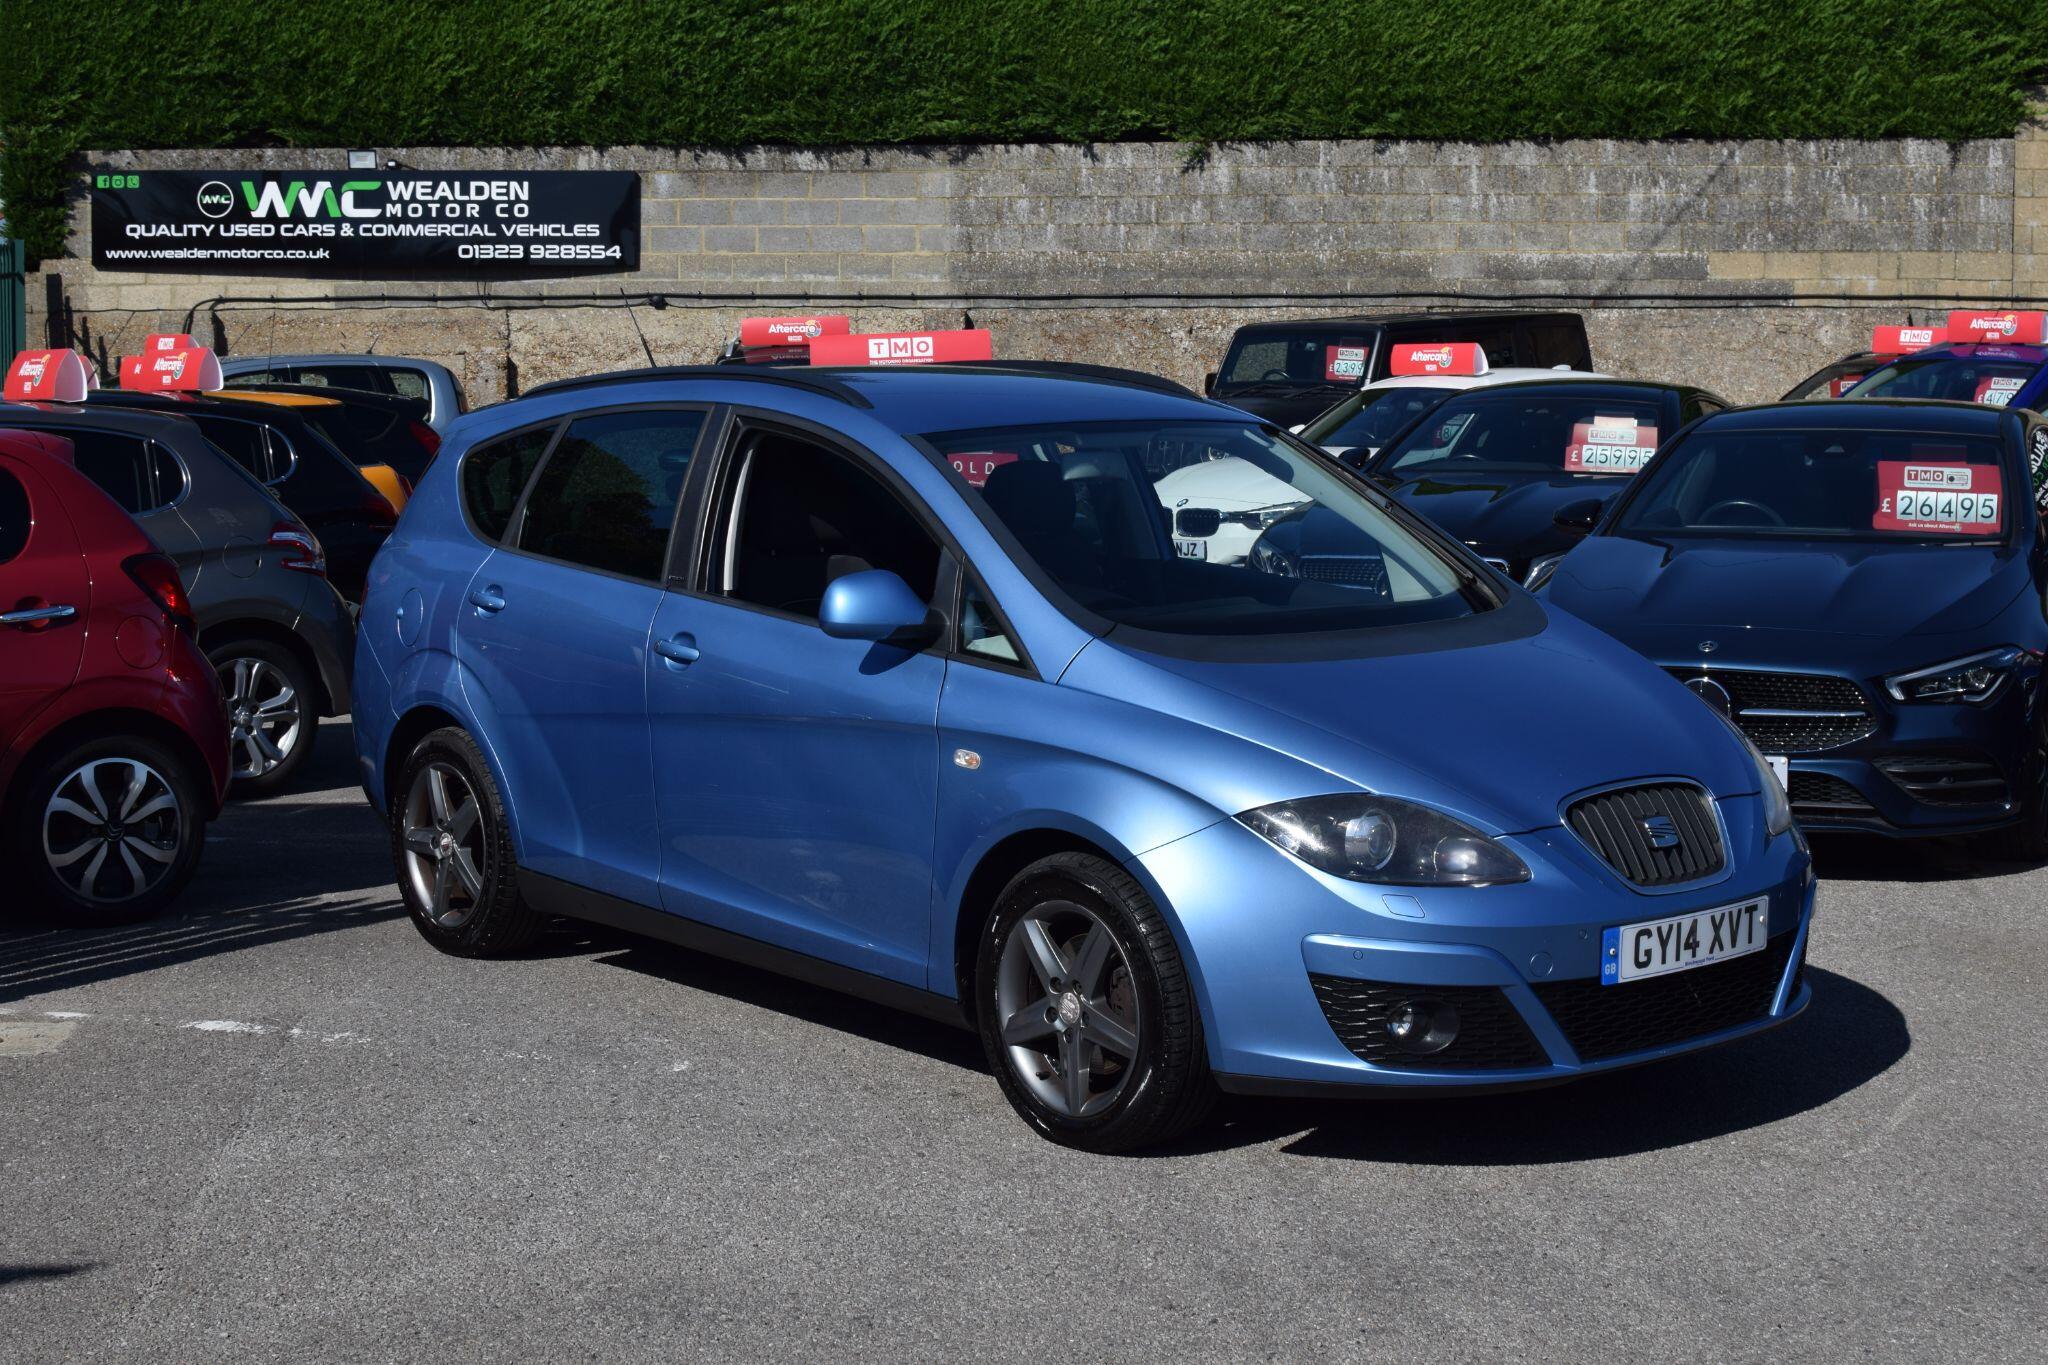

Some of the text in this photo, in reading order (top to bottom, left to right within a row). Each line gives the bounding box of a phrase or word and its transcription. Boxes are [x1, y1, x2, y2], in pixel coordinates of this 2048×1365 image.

[386, 181, 530, 201] WEALDEN
[241, 181, 382, 218] WMC
[386, 203, 530, 218] MOTOR CO
[125, 223, 600, 238] QUALITY USED CARS & COMMERCIAL VEHICLES
[105, 247, 330, 260] www.wealdenmotorco.co.uk
[458, 244, 622, 260] 01323 928554
[768, 323, 816, 334] Aftercare
[1970, 318, 2013, 329] Aftercare
[1901, 331, 1931, 341] TMO
[871, 339, 931, 356] TMO
[1410, 350, 1448, 362] Aftercare
[953, 460, 995, 475] OLD
[1908, 470, 1944, 481] TMO
[1634, 903, 1759, 970] GY14 XVT
[1604, 962, 1617, 976] GB
